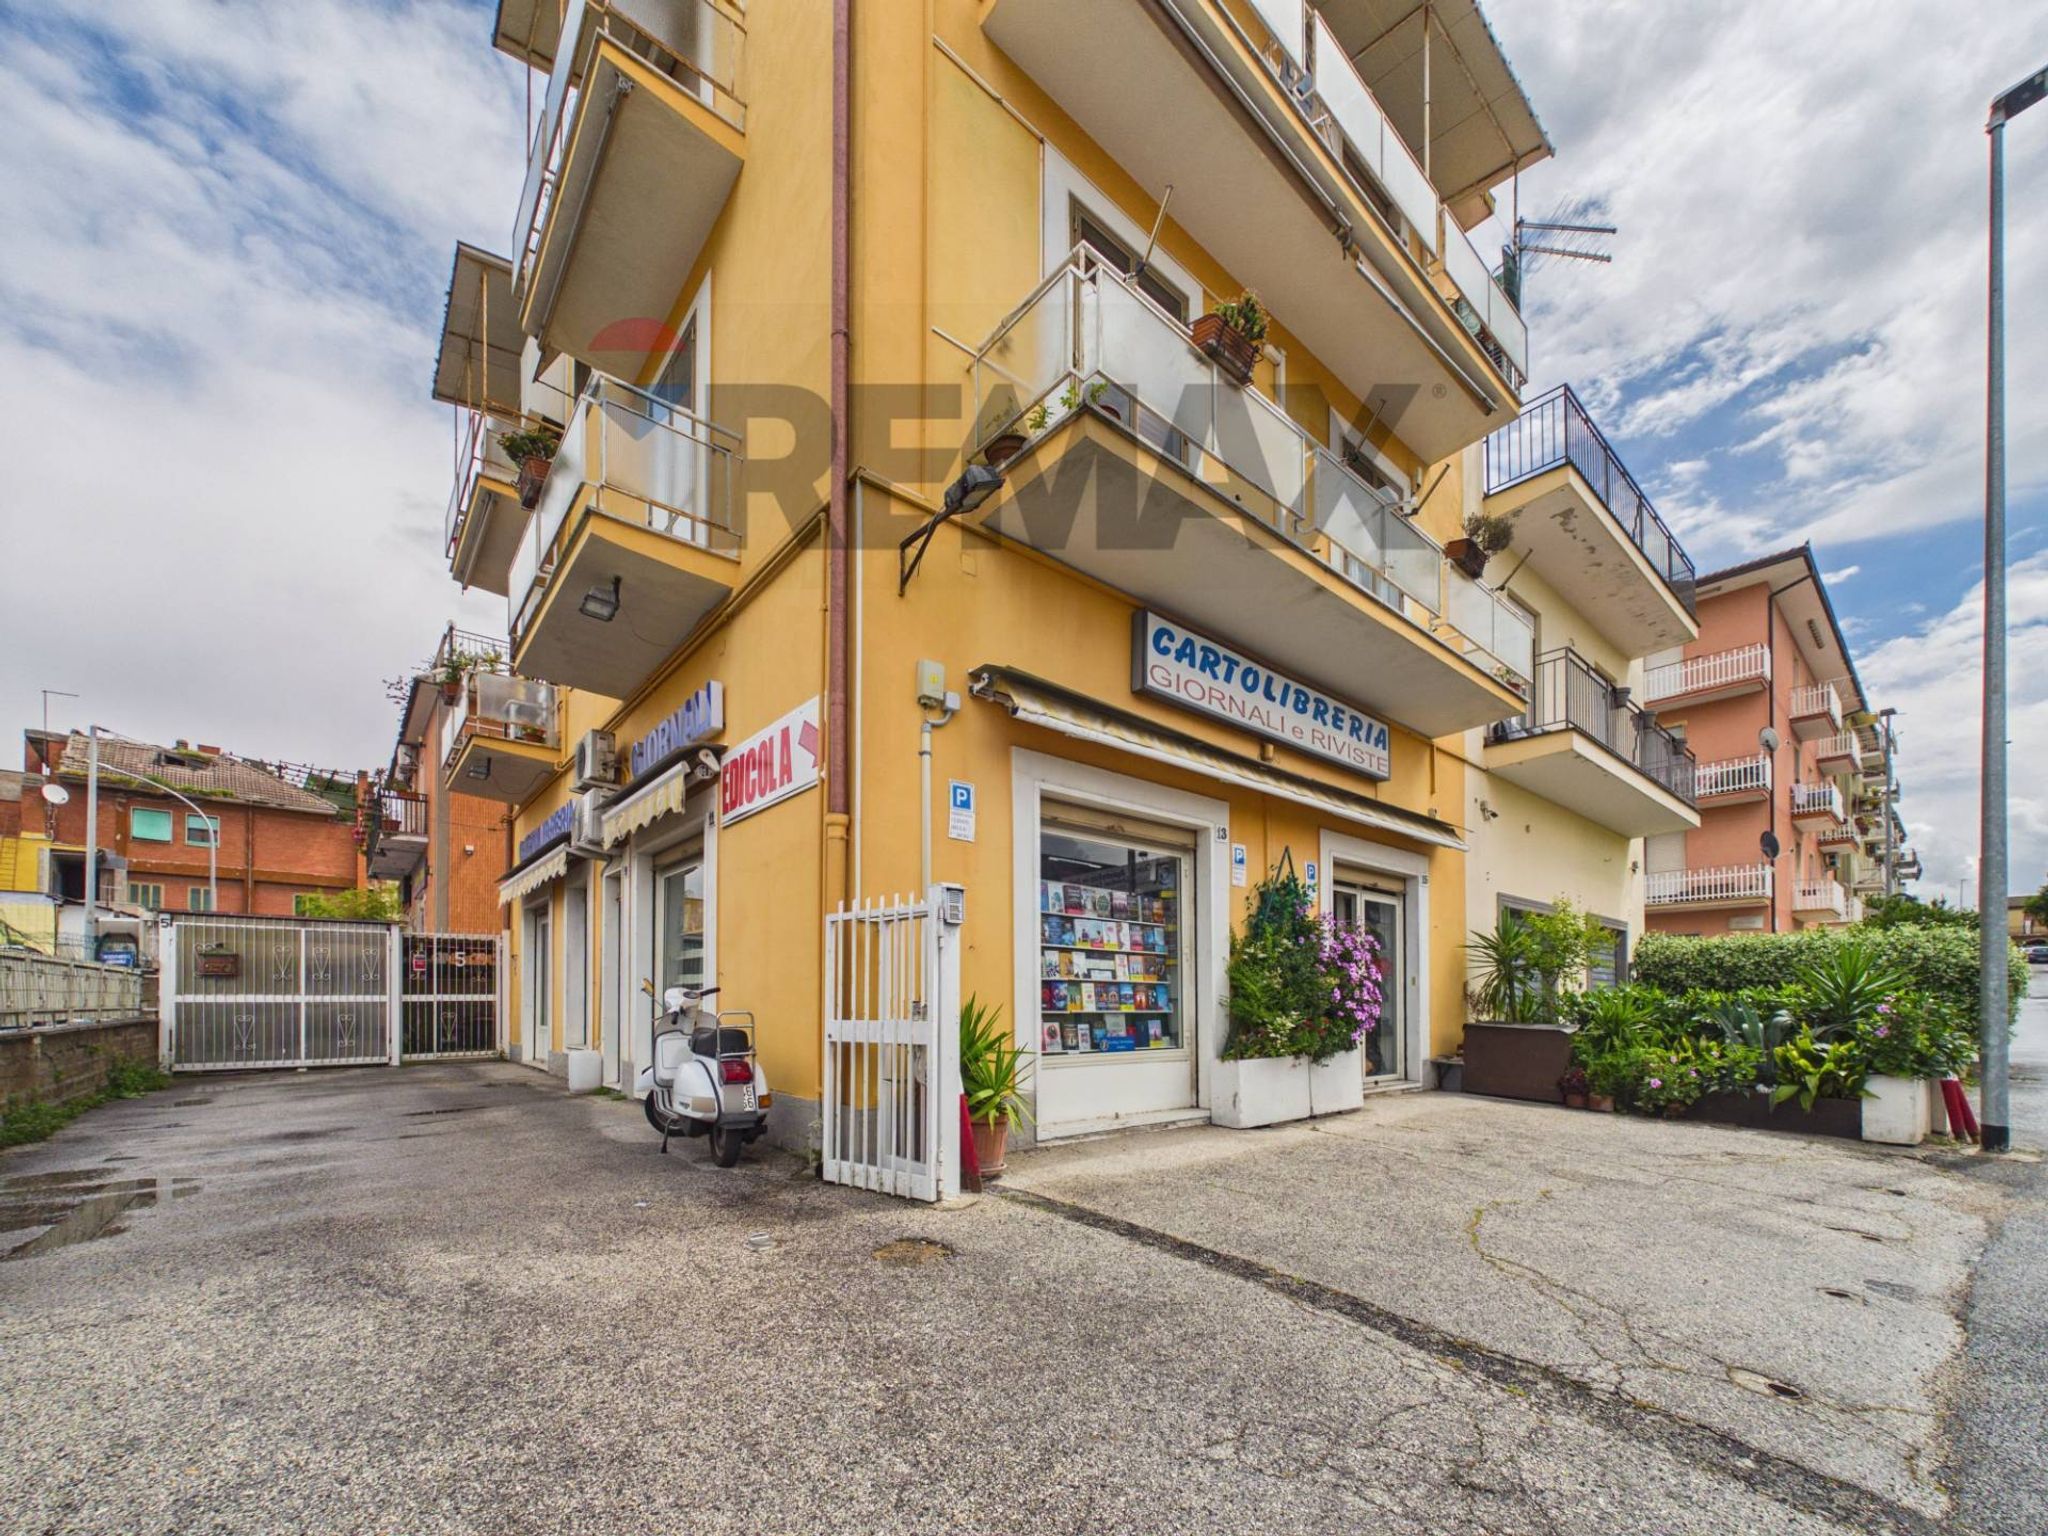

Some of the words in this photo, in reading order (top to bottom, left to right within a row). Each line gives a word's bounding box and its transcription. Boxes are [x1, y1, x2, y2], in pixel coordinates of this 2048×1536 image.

[632, 680, 716, 777] GIORNALI
[1149, 664, 1286, 734] GIORNALI
[1291, 726, 1304, 740] e
[1311, 728, 1388, 774] RIVISTE
[1152, 627, 1388, 751] CARTOLIBRERIA
[722, 726, 793, 816] EDICOLA
[1217, 826, 1227, 840] 13
[455, 951, 466, 967] 5
